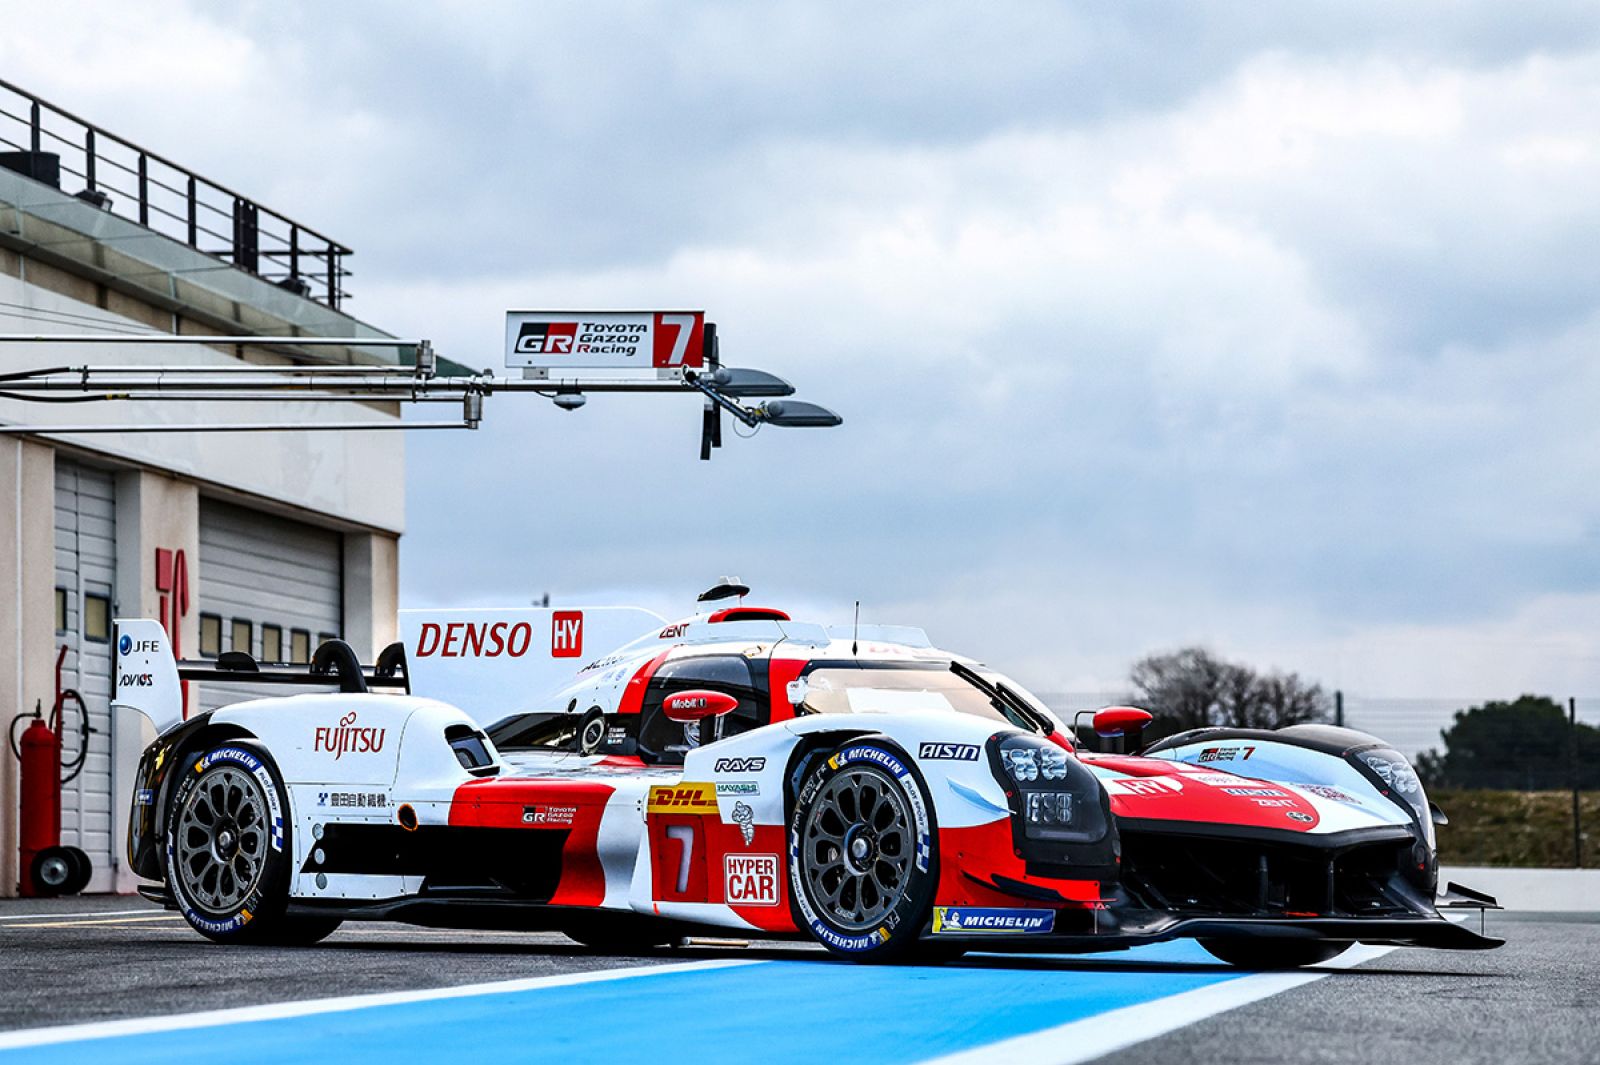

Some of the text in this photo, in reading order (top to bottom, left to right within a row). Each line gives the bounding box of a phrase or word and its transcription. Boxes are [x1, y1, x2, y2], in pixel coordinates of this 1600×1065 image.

[582, 322, 648, 333] TOYOTA
[517, 335, 573, 353] GR
[579, 333, 641, 343] GAZOO
[661, 315, 695, 365] 7
[576, 344, 637, 357] Racing
[554, 619, 581, 650] HY
[659, 623, 690, 639] ZENT
[133, 640, 159, 652] JFE
[416, 623, 532, 657] DENSO
[672, 698, 697, 708] Mobil
[315, 727, 386, 760] FUJITSU
[920, 743, 979, 760] AISIN
[210, 749, 257, 769] MICHELIN
[848, 748, 903, 775] MICHELIN
[1243, 747, 1256, 760] 7
[715, 757, 766, 772] RAYS
[656, 789, 707, 806] DHL
[523, 812, 545, 822] GR
[667, 825, 694, 893] 7
[728, 859, 774, 874] HYPER
[728, 875, 774, 900] CAR
[963, 916, 1043, 927] MICHELIN
[815, 923, 869, 949] MICHELIN
